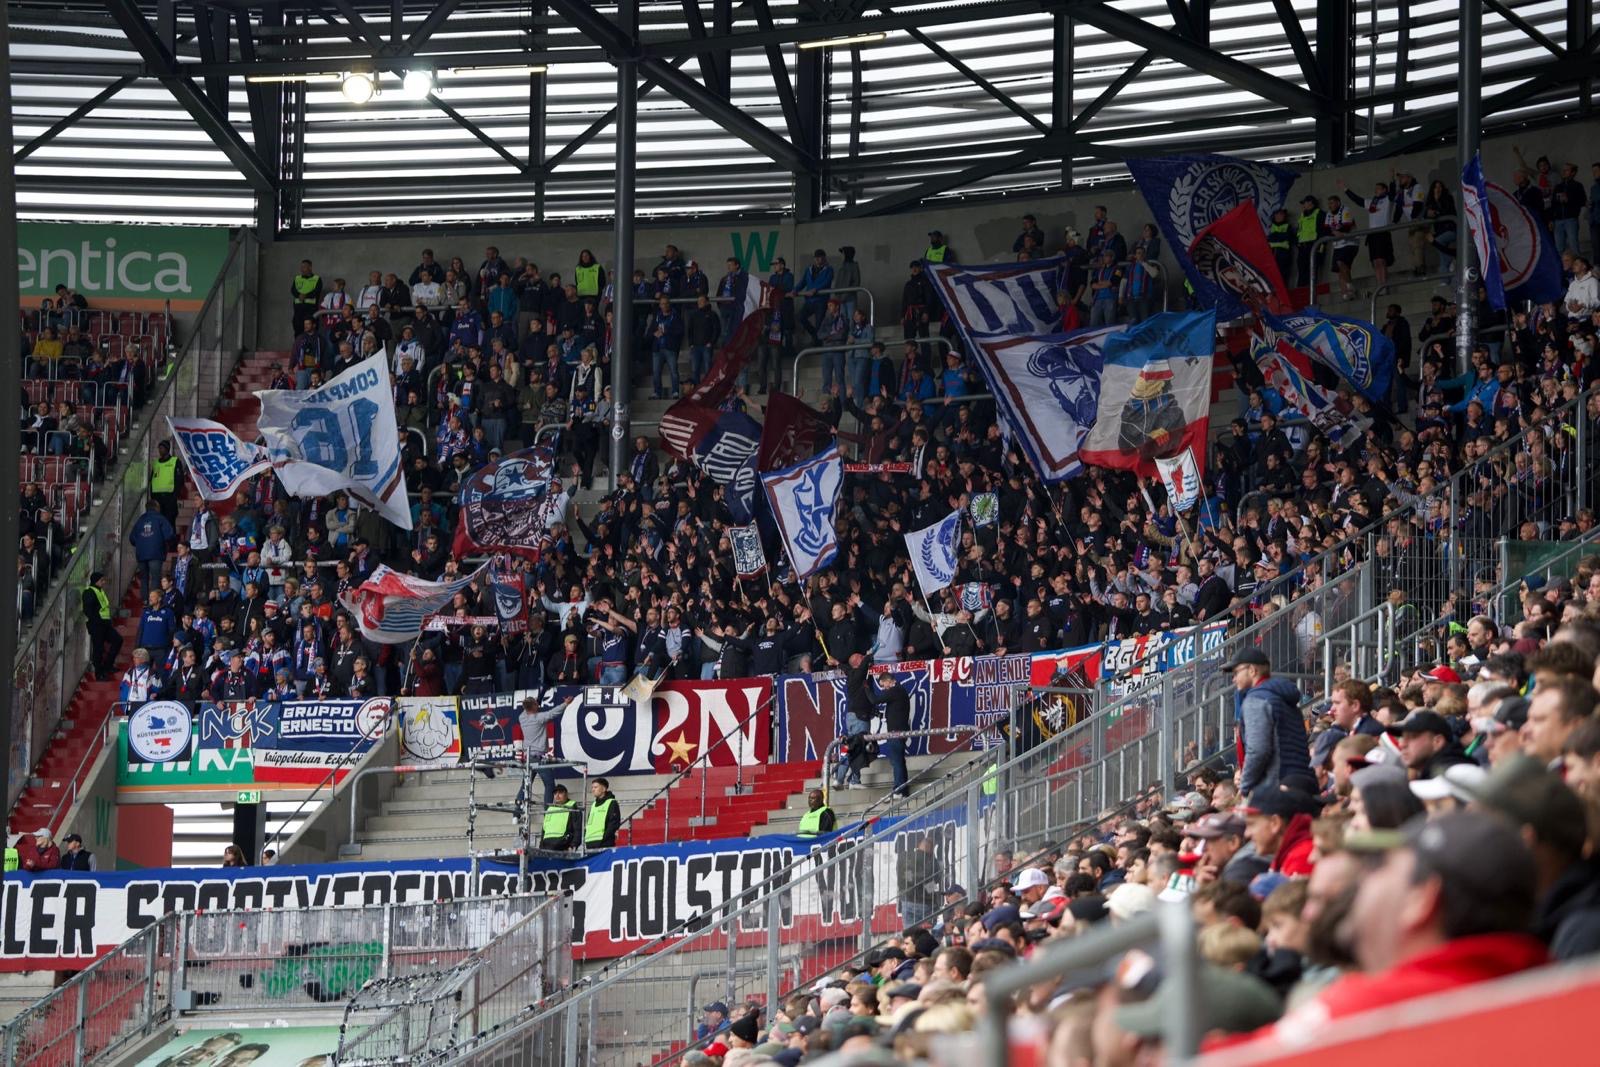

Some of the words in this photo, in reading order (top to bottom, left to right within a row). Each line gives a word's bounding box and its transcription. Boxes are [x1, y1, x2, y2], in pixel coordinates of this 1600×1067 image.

[18, 238, 192, 293] entica
[730, 230, 779, 272] W
[975, 659, 997, 685] AM
[998, 656, 1031, 684] ENDE
[283, 705, 354, 718] GRUPPO
[462, 696, 513, 710] NUCLEO
[280, 718, 355, 733] ERNESTO
[1, 881, 97, 956] LER
[610, 848, 794, 941] HOLSTEIN
